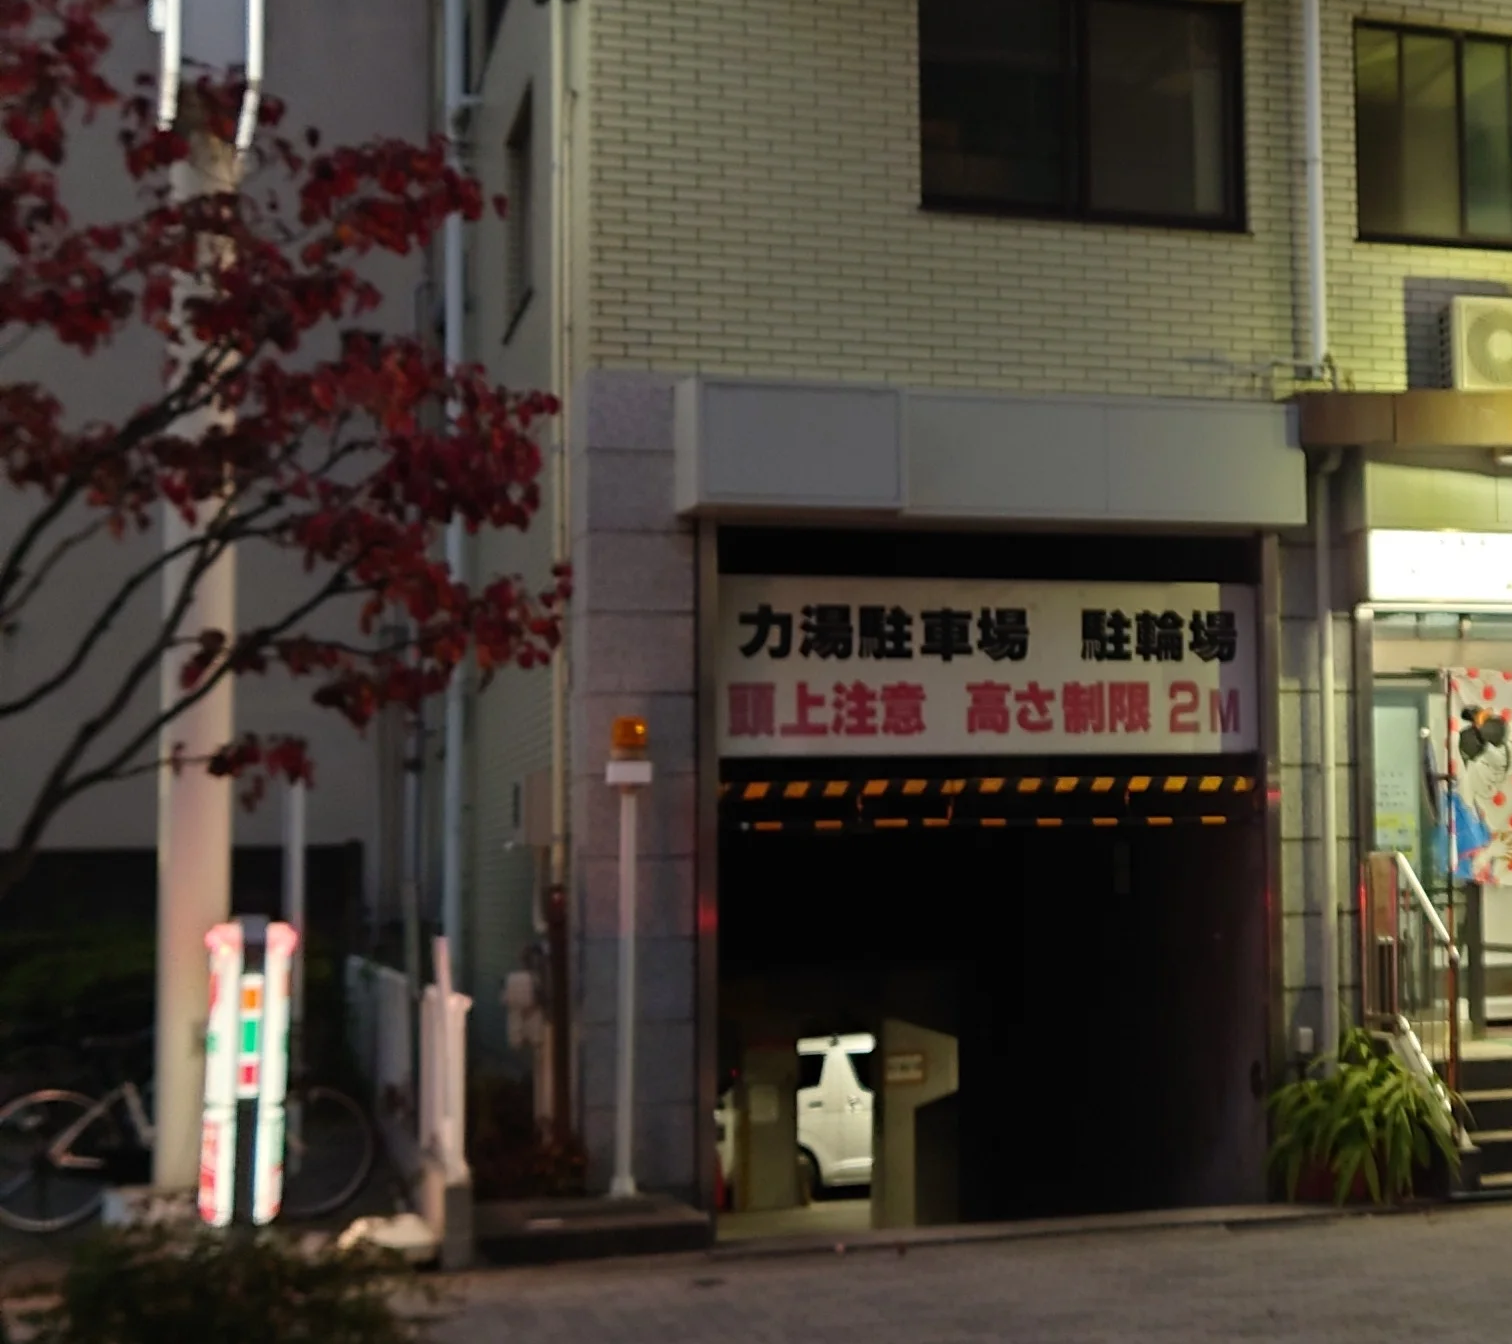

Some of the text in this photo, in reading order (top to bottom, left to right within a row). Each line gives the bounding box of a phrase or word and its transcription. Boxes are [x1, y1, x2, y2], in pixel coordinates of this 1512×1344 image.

[739, 603, 1238, 663] 力湯駐車場 駐輪場
[727, 679, 928, 738] 頭上注意
